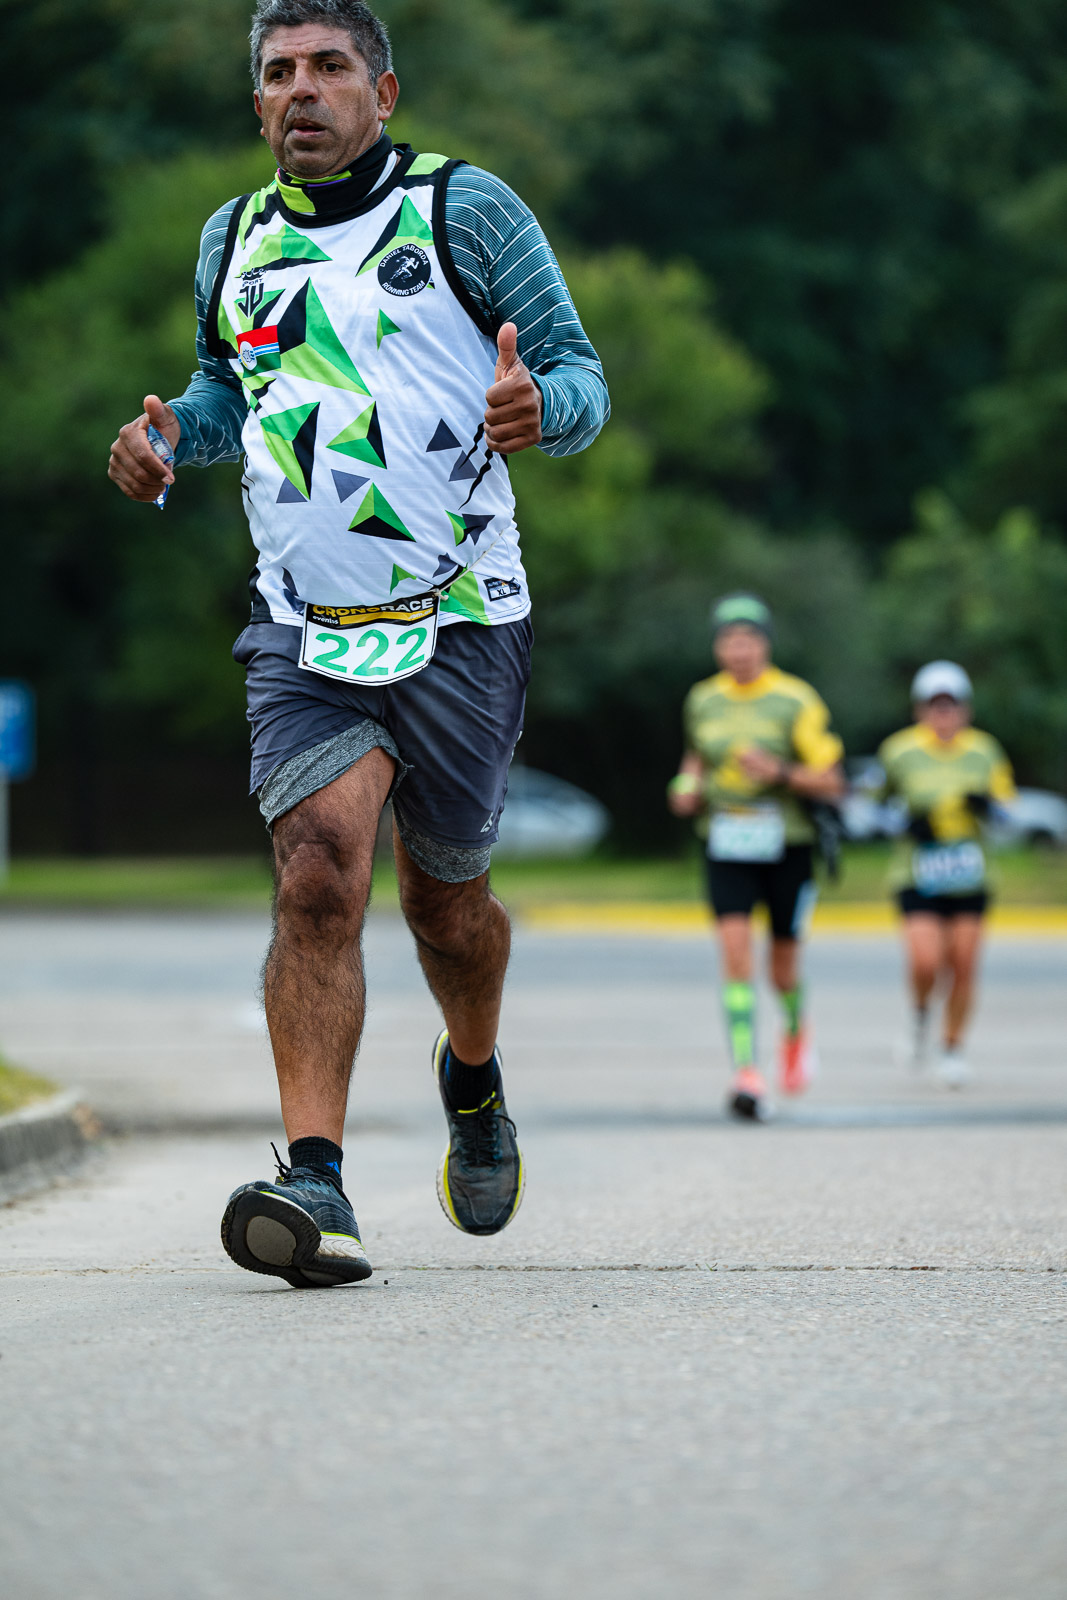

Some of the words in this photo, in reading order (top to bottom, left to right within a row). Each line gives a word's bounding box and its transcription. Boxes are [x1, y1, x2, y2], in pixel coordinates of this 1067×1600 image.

[379, 249, 401, 268] DANIEL
[402, 244, 429, 265] TABORDA
[382, 281, 410, 296] RUNNING
[409, 280, 426, 294] TEAM
[312, 627, 428, 676] 222
